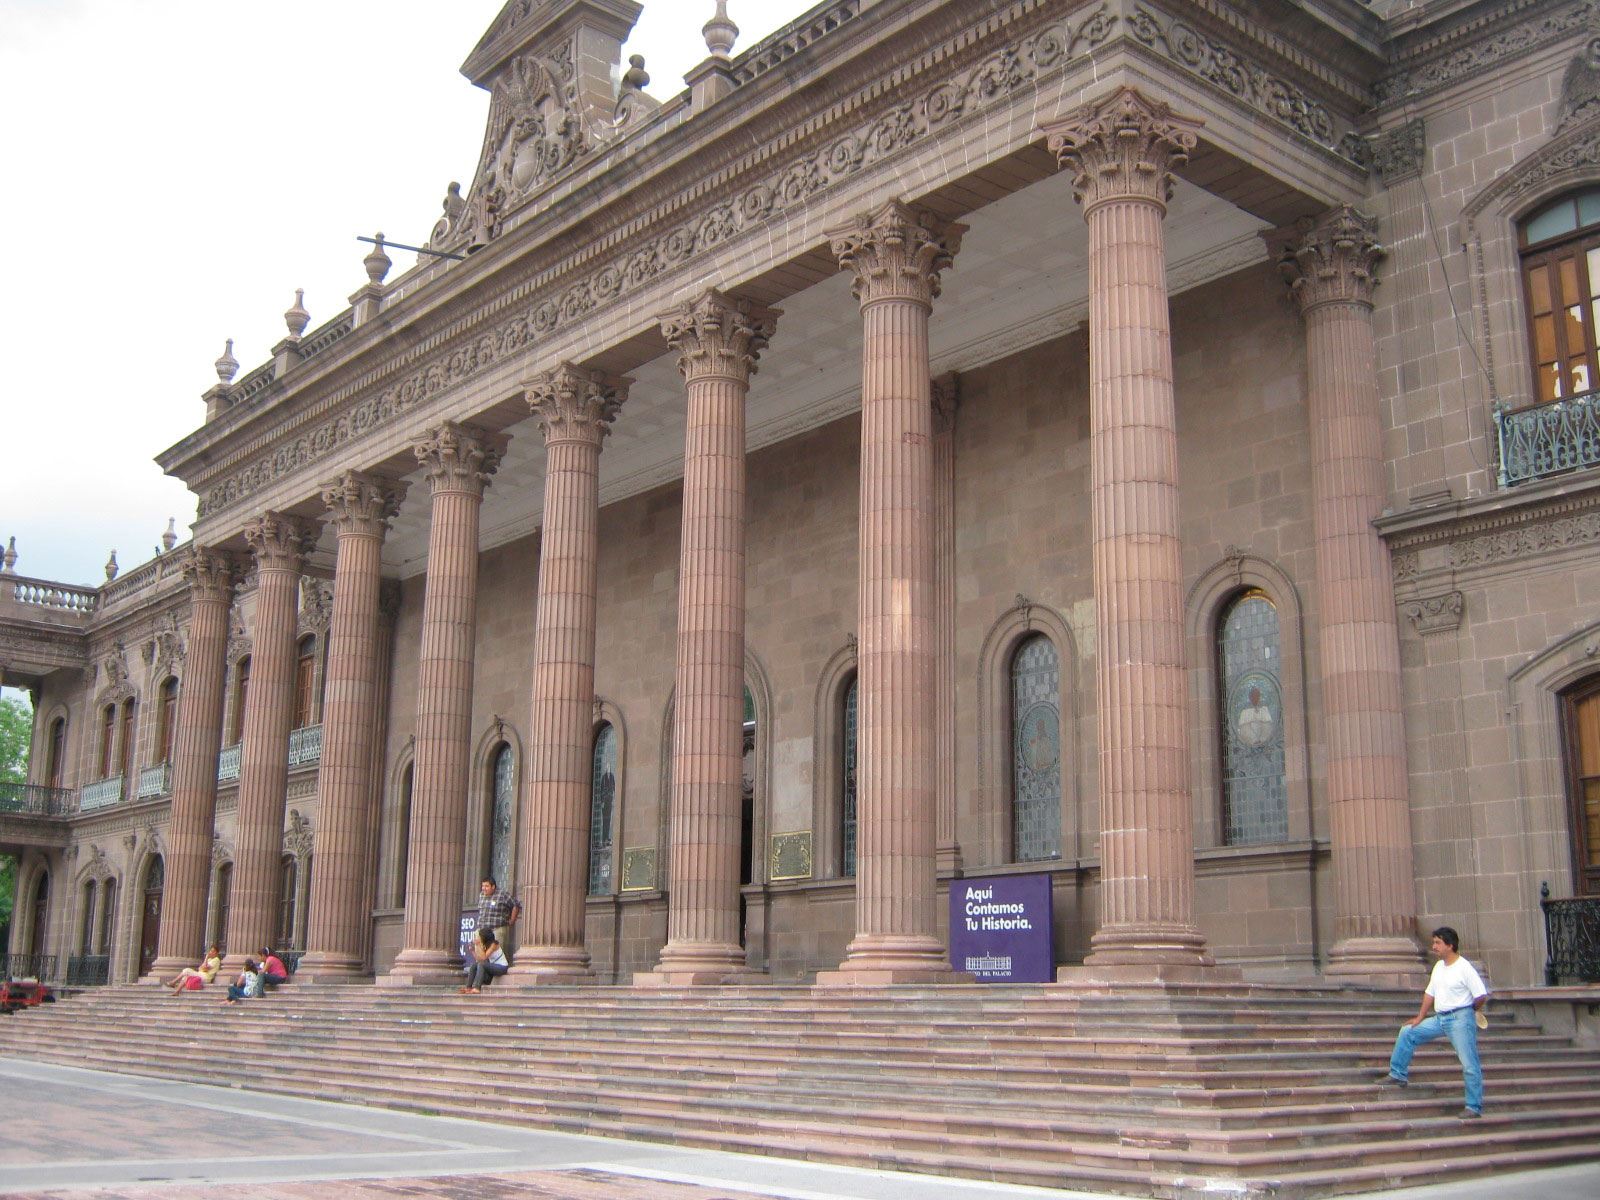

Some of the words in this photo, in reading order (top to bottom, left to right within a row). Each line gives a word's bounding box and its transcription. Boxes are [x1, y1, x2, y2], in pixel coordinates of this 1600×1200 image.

[966, 885, 993, 903] Aquí
[966, 902, 1024, 915] Contamos
[461, 918, 475, 930] SEO
[966, 918, 978, 931] Tu
[982, 915, 1032, 931] Historia.
